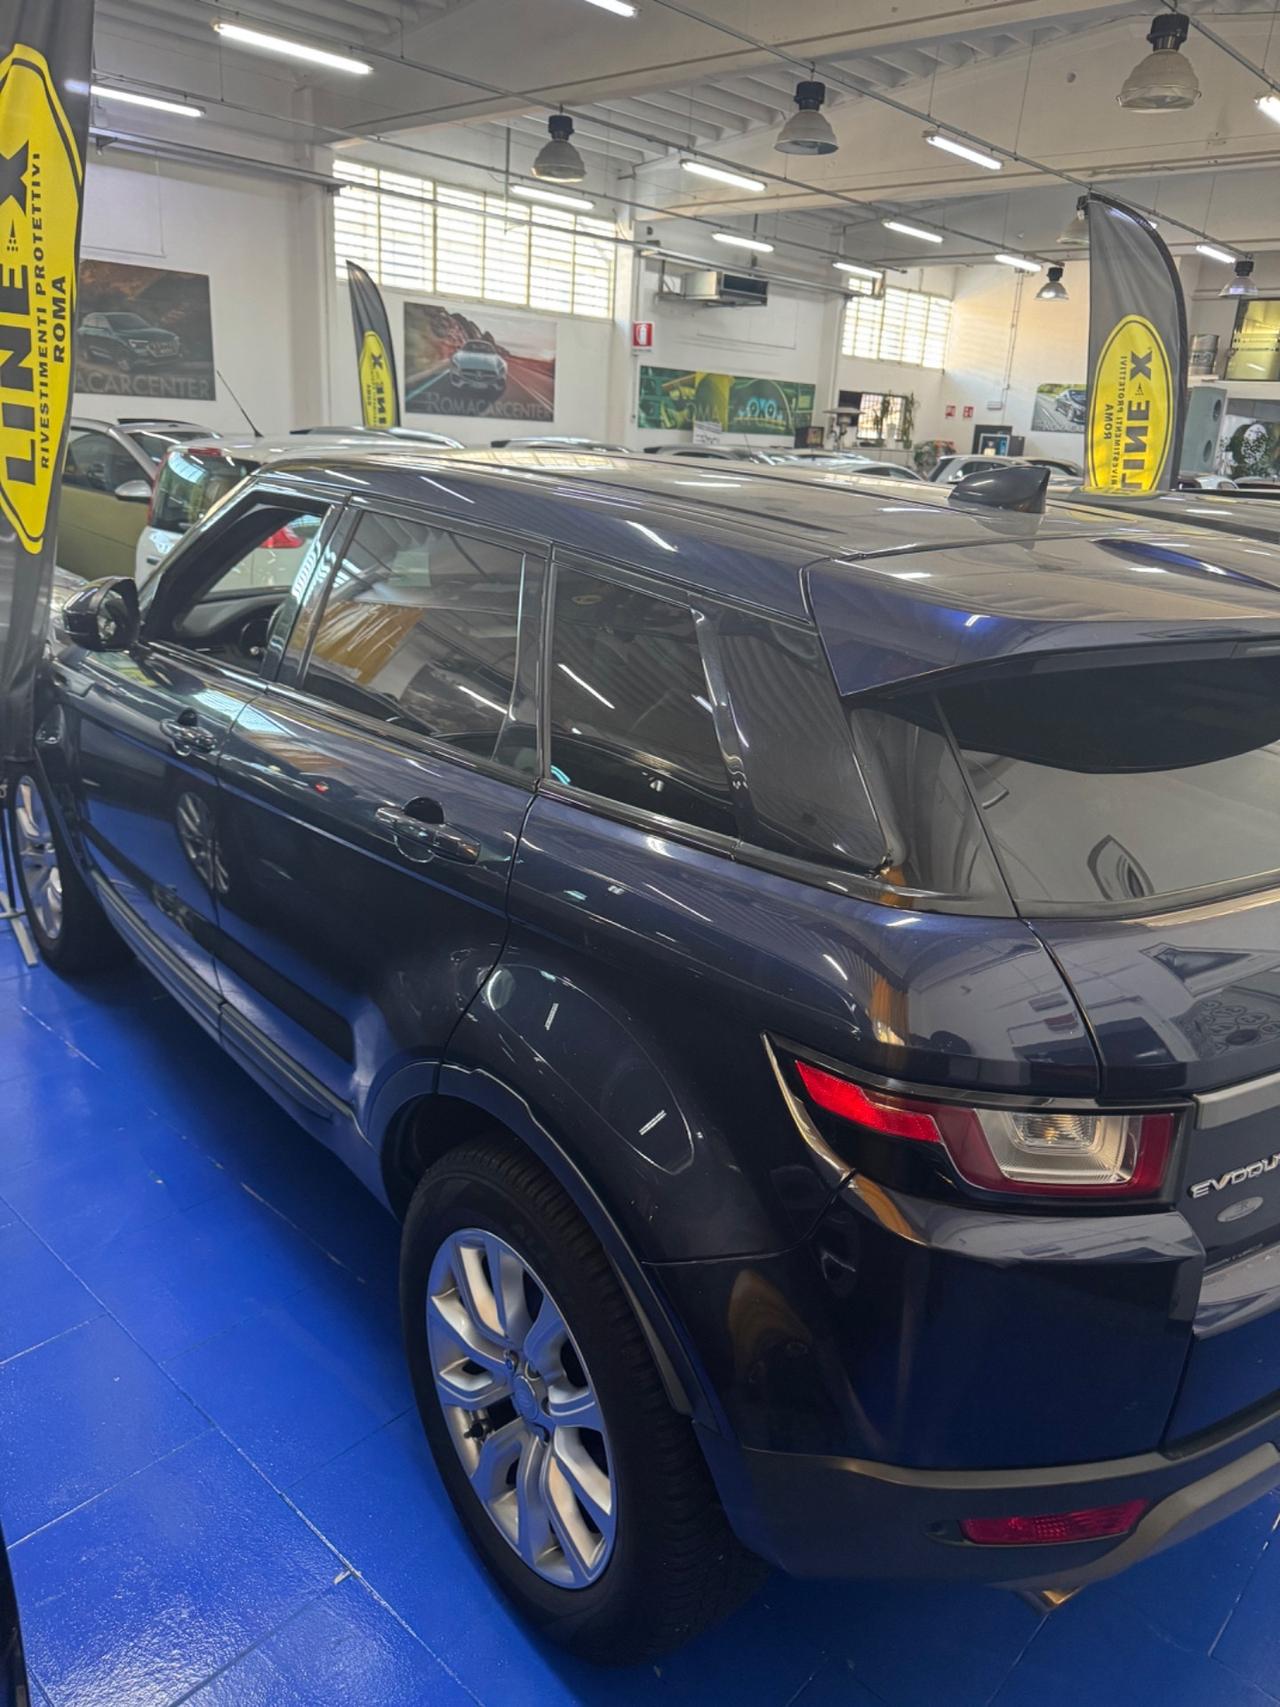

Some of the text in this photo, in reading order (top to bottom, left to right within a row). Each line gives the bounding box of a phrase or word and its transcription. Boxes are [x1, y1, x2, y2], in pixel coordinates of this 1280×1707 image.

[31, 153, 50, 469] RIVESTIMENTI PROTETTIVI
[52, 276, 68, 363] ROMA
[77, 371, 210, 399] ACARCENTER
[1189, 1152, 1280, 1198] EVOQU
